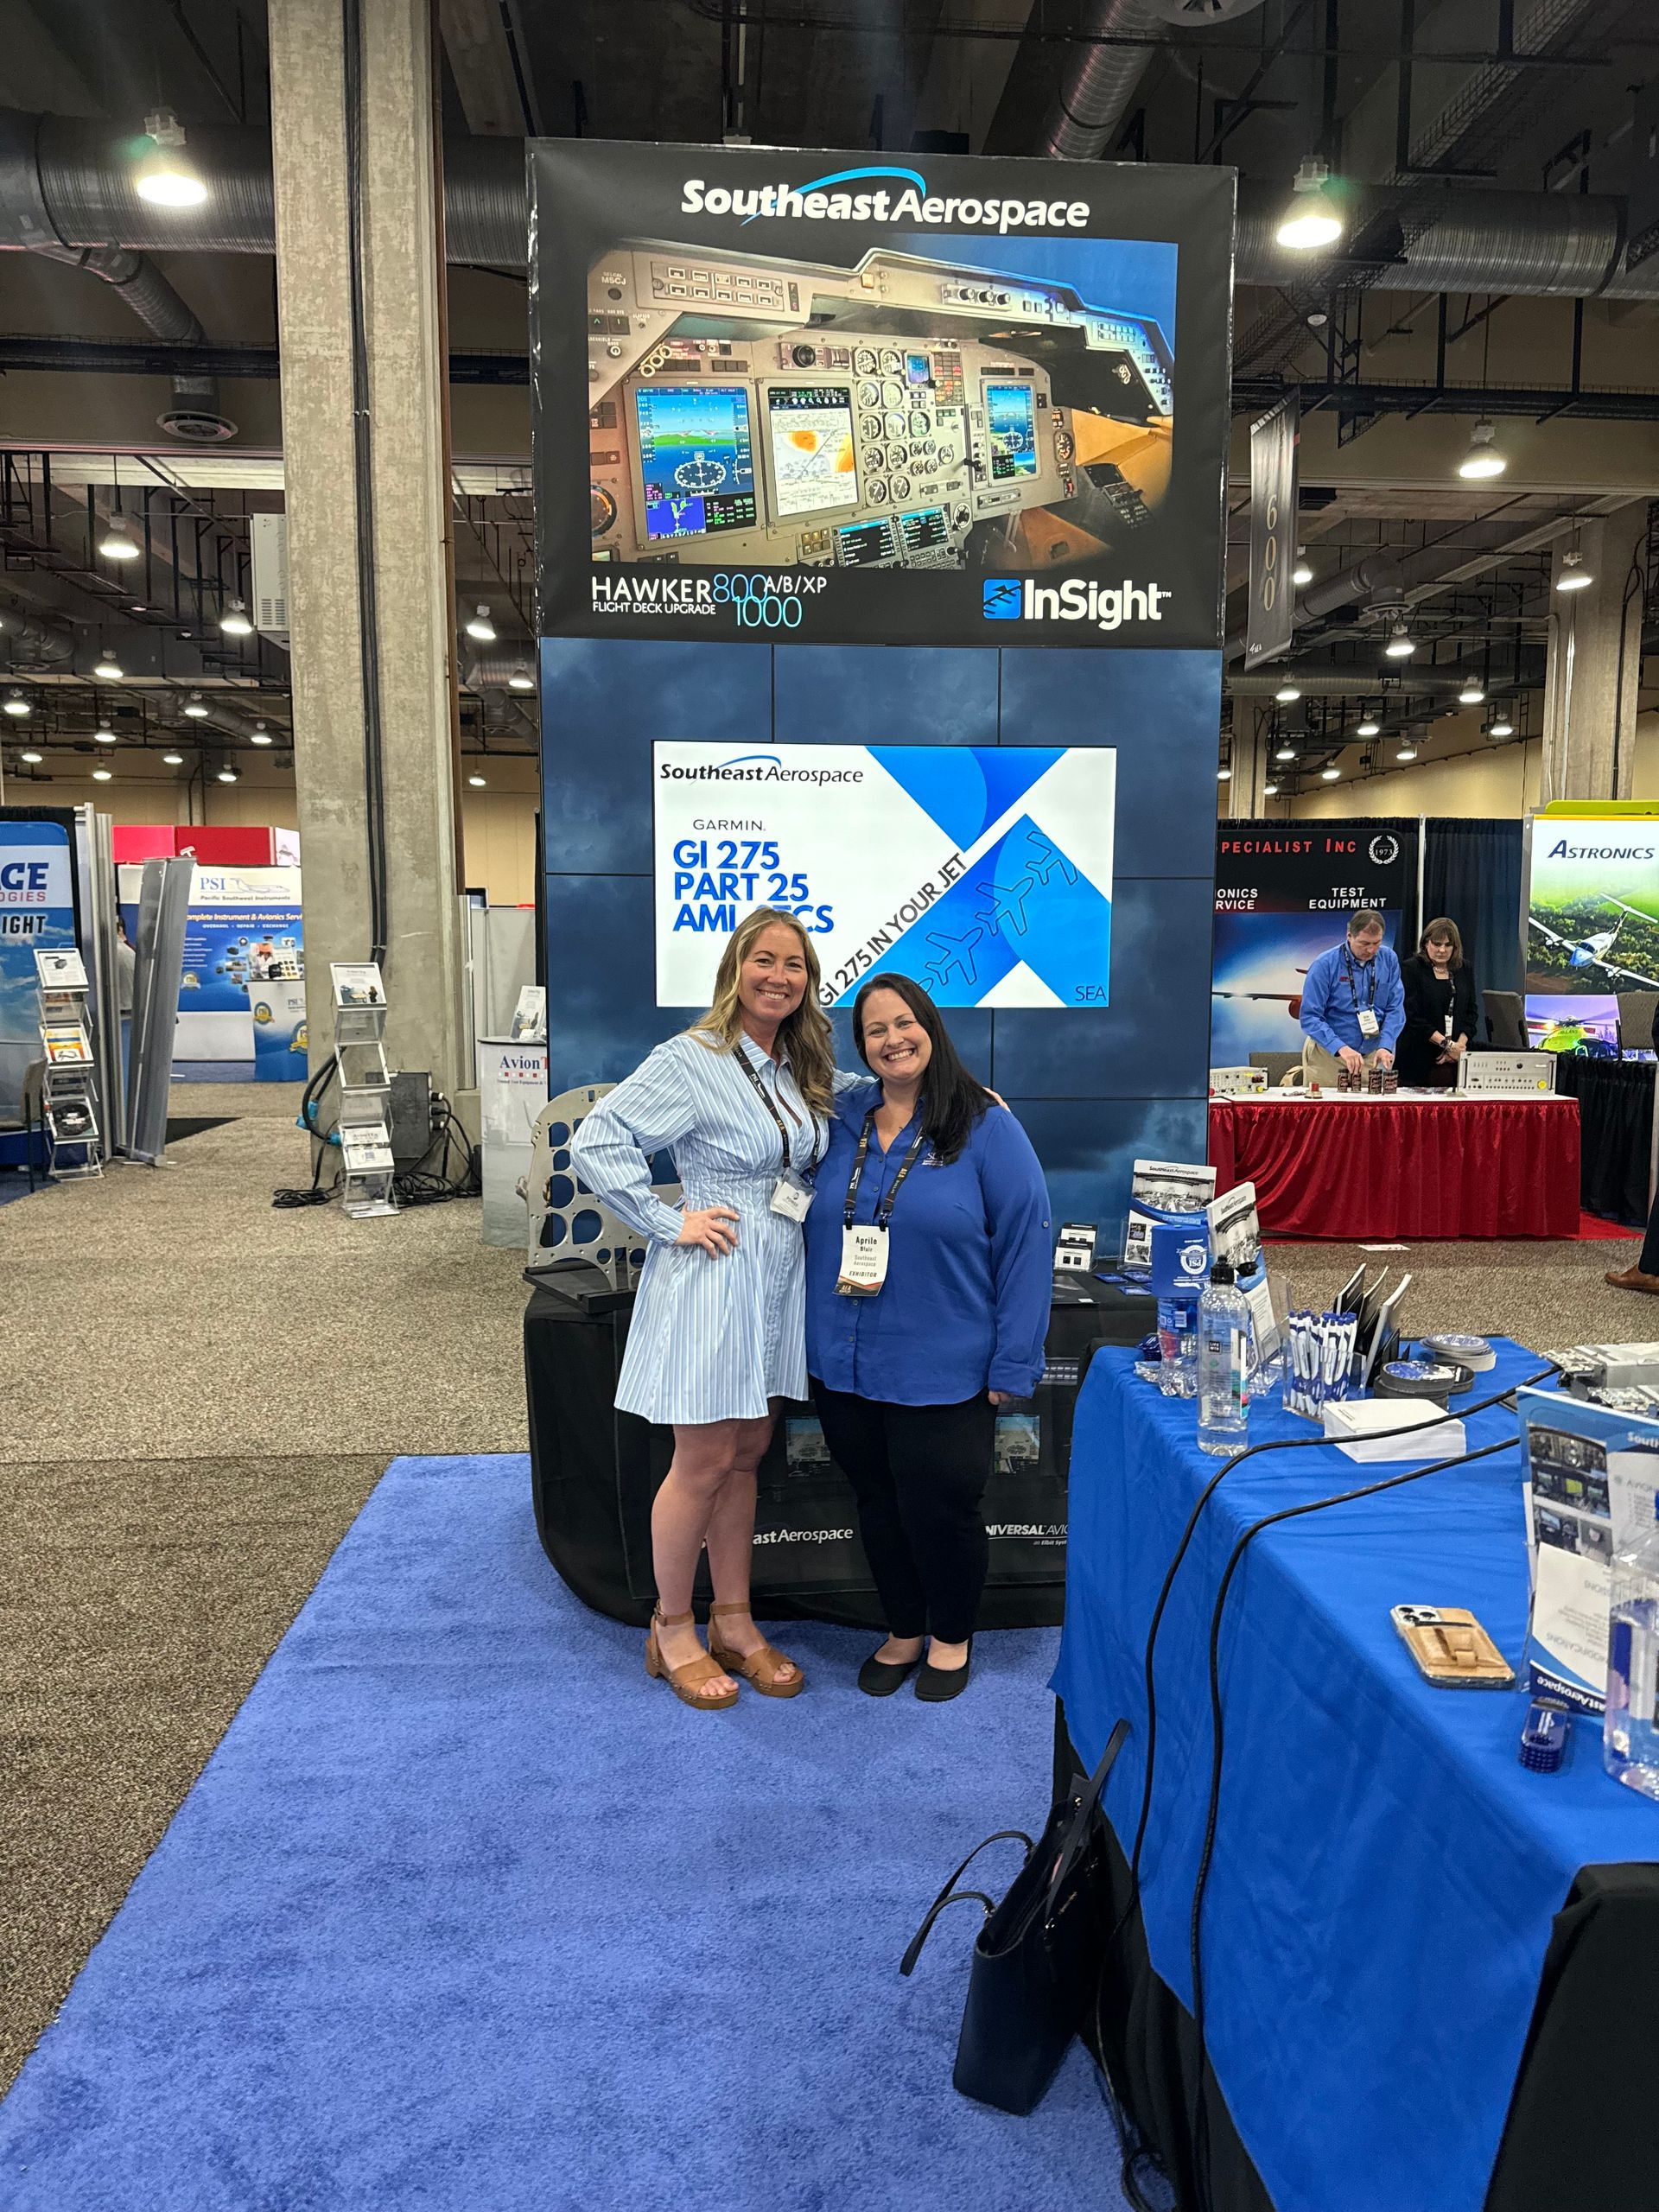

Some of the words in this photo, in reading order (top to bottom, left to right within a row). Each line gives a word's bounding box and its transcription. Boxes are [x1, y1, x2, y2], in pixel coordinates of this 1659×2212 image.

[592, 576, 712, 603] HAWKER
[712, 573, 767, 603] 800
[764, 575, 827, 594] A/B/XP
[593, 601, 630, 613] FLIGHT
[633, 602, 663, 613] DECK
[664, 603, 716, 615] UPGRADE
[734, 595, 803, 627] 1000
[673, 840, 707, 868] GI
[716, 841, 780, 869] 275
[1217, 841, 1313, 854] PECIALIST
[0, 862, 49, 890] CE
[200, 877, 226, 890] PSI
[674, 872, 760, 900] PART
[767, 874, 809, 901] 25
[1217, 888, 1258, 899] ONICS
[1332, 887, 1365, 897] TEST
[1308, 898, 1387, 909] EQUIPMENT
[756, 905, 835, 933] CS
[835, 949, 873, 988] 275
[867, 928, 893, 956] IN
[885, 882, 943, 933] YOUR
[938, 852, 967, 888] JET
[1075, 985, 1106, 1001] SEA
[855, 1236, 877, 1245] Aprile
